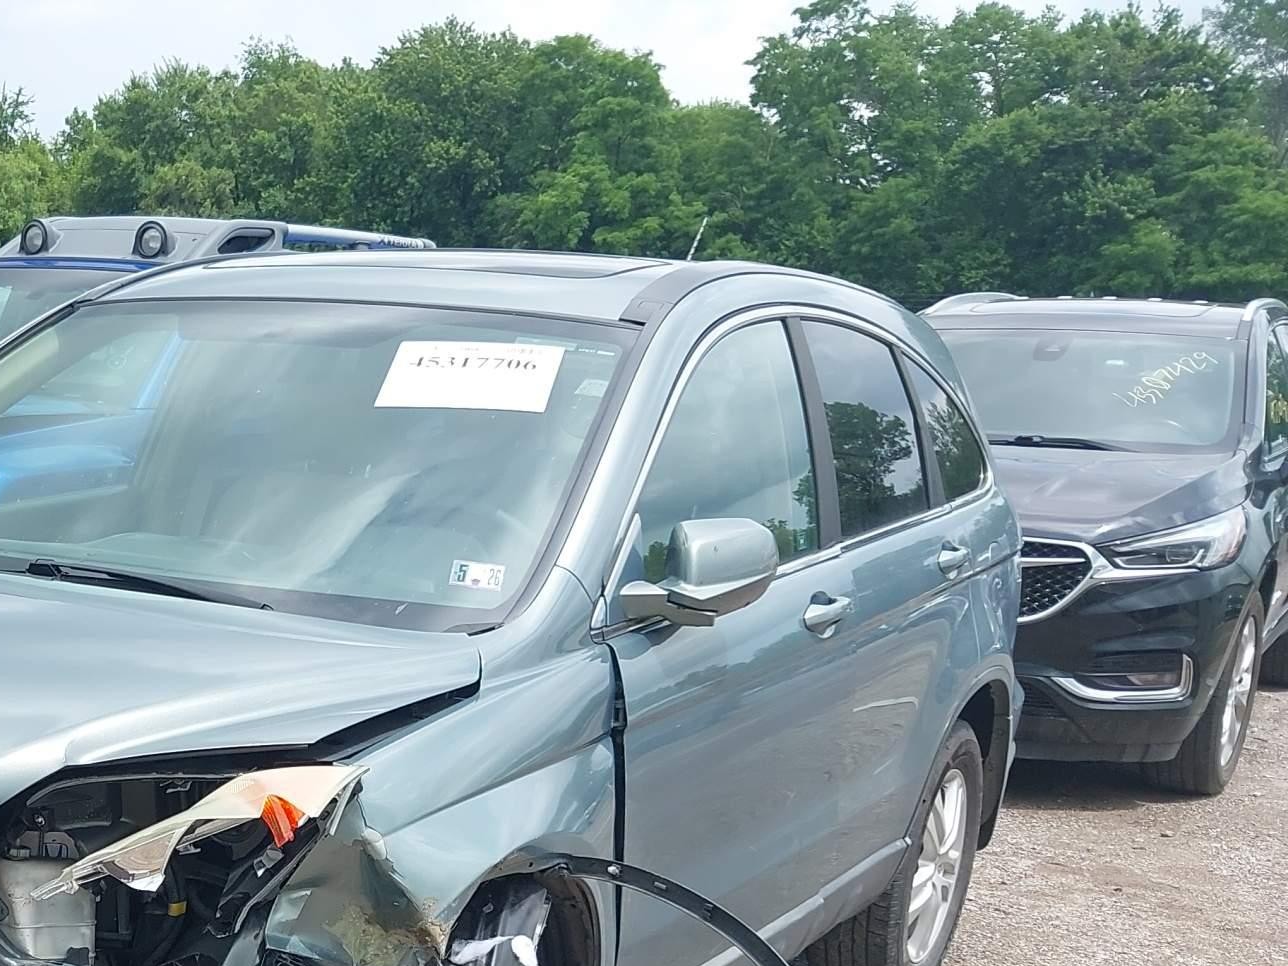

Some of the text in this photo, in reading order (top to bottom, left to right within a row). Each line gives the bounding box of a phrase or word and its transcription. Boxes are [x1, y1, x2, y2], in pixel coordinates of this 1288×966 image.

[409, 356, 537, 370] 45317706
[457, 564, 501, 586] 5 26
